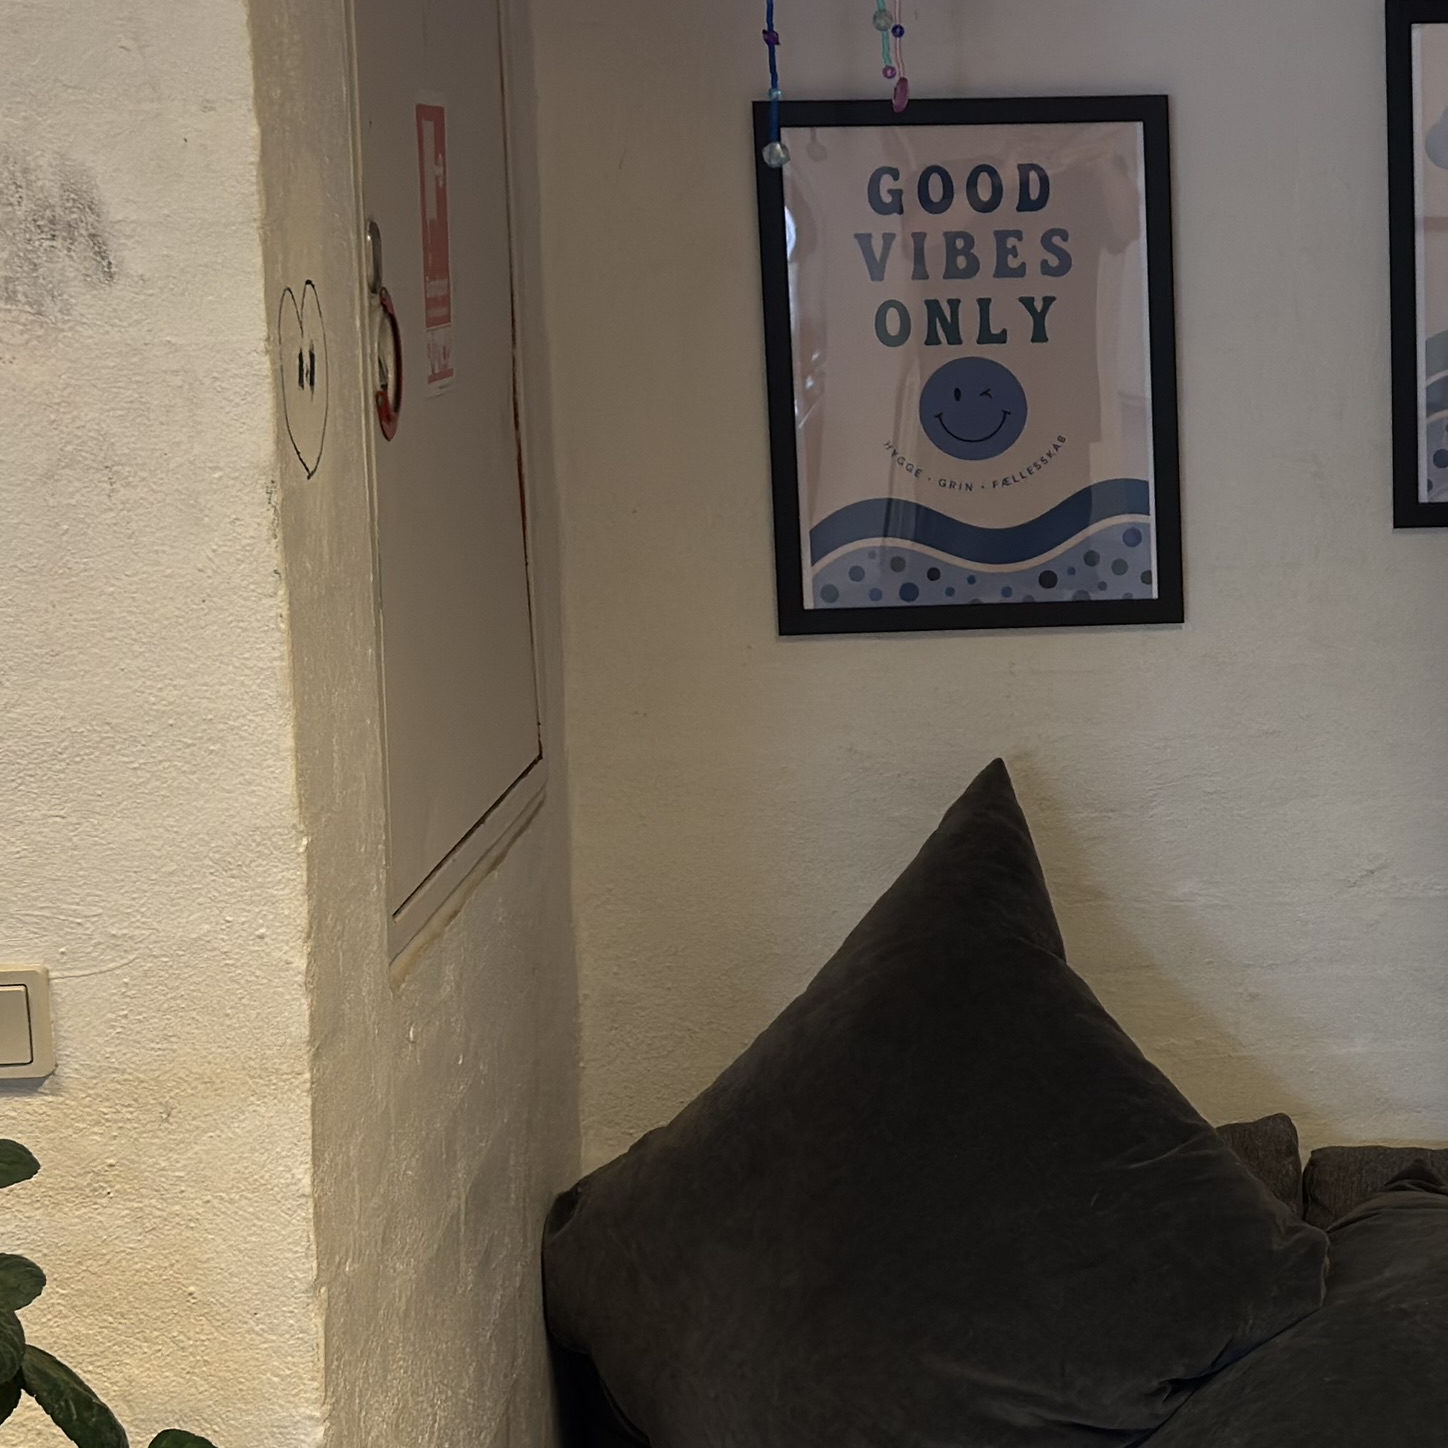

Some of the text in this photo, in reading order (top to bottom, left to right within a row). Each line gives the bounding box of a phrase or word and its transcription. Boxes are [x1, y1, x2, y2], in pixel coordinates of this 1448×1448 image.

[867, 163, 1051, 216] GOOD
[853, 228, 1073, 282] VIBES
[874, 296, 1057, 348] ONLY
[883, 434, 1067, 492] HYGGE GRIN FÆLLESSKAB
